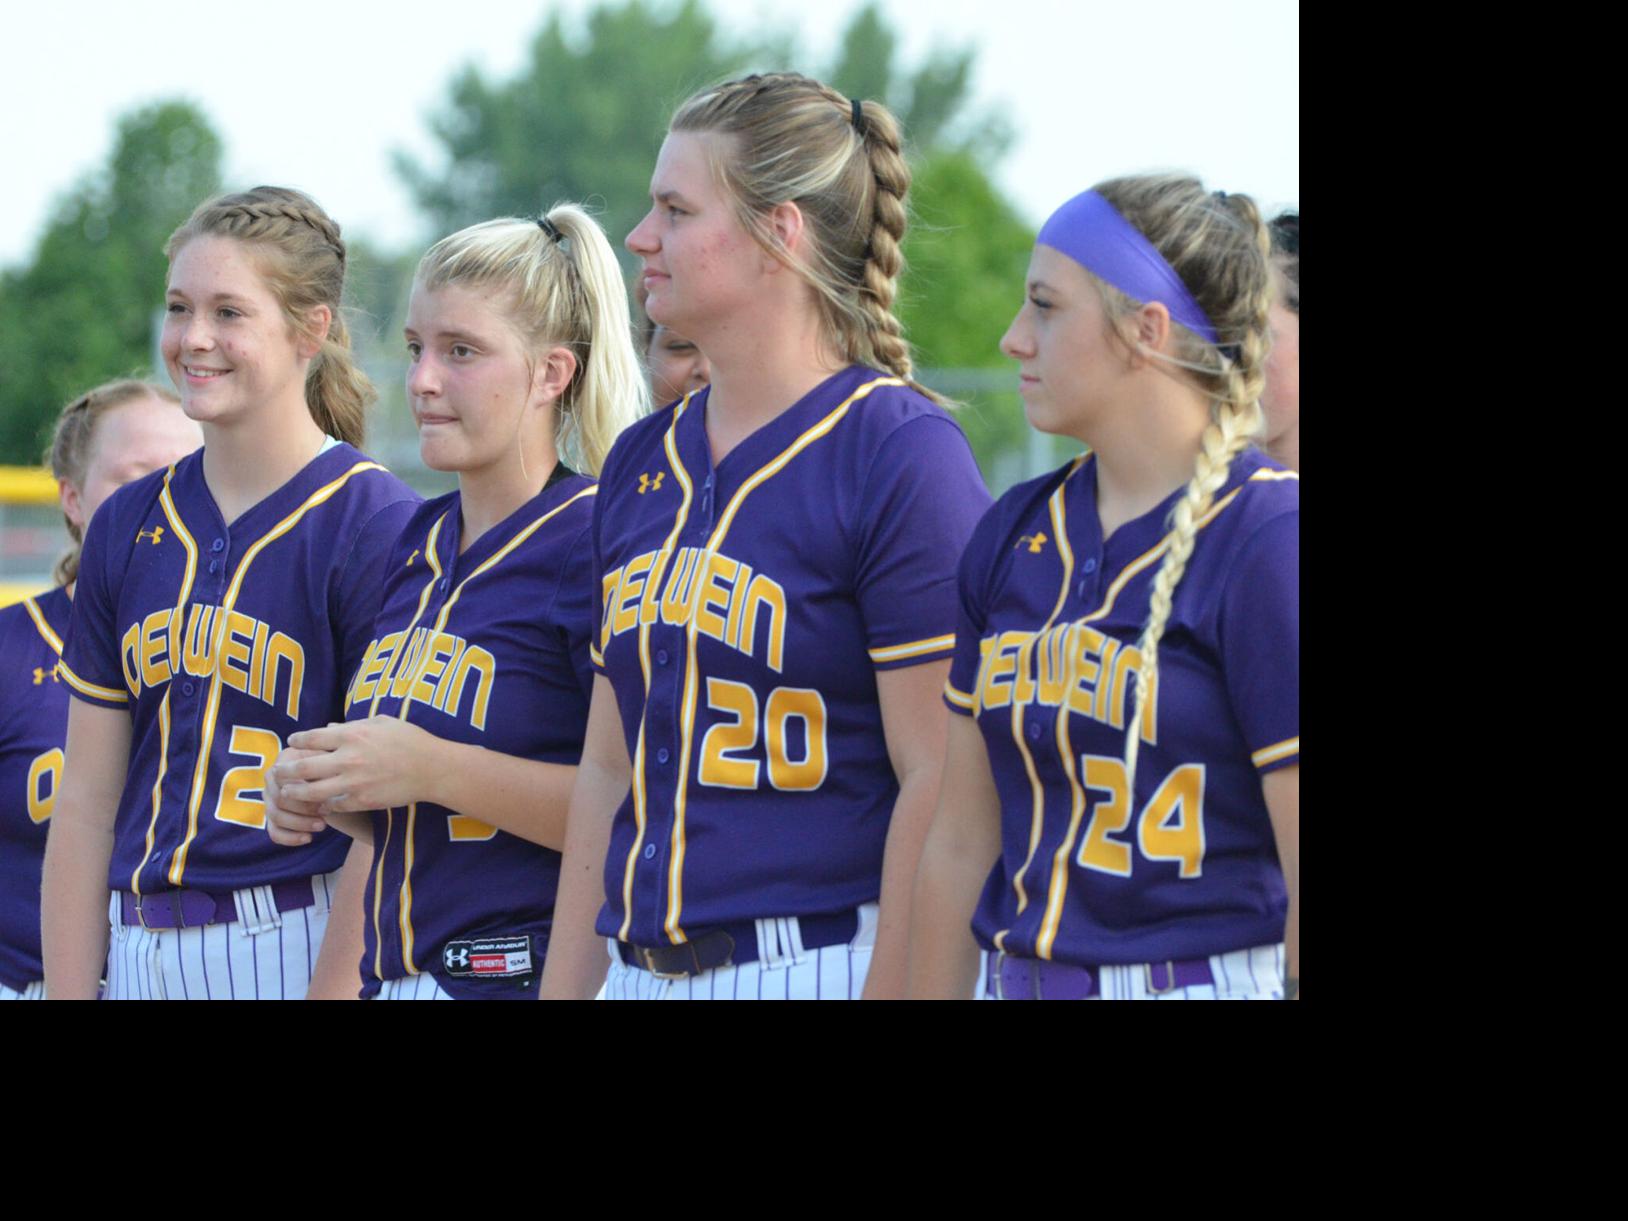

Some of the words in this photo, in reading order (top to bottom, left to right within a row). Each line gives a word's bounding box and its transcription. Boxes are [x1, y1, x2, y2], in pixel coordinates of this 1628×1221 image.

[600, 547, 787, 674] OELWEIN
[697, 676, 829, 791] 20
[1076, 754, 1206, 879] 24
